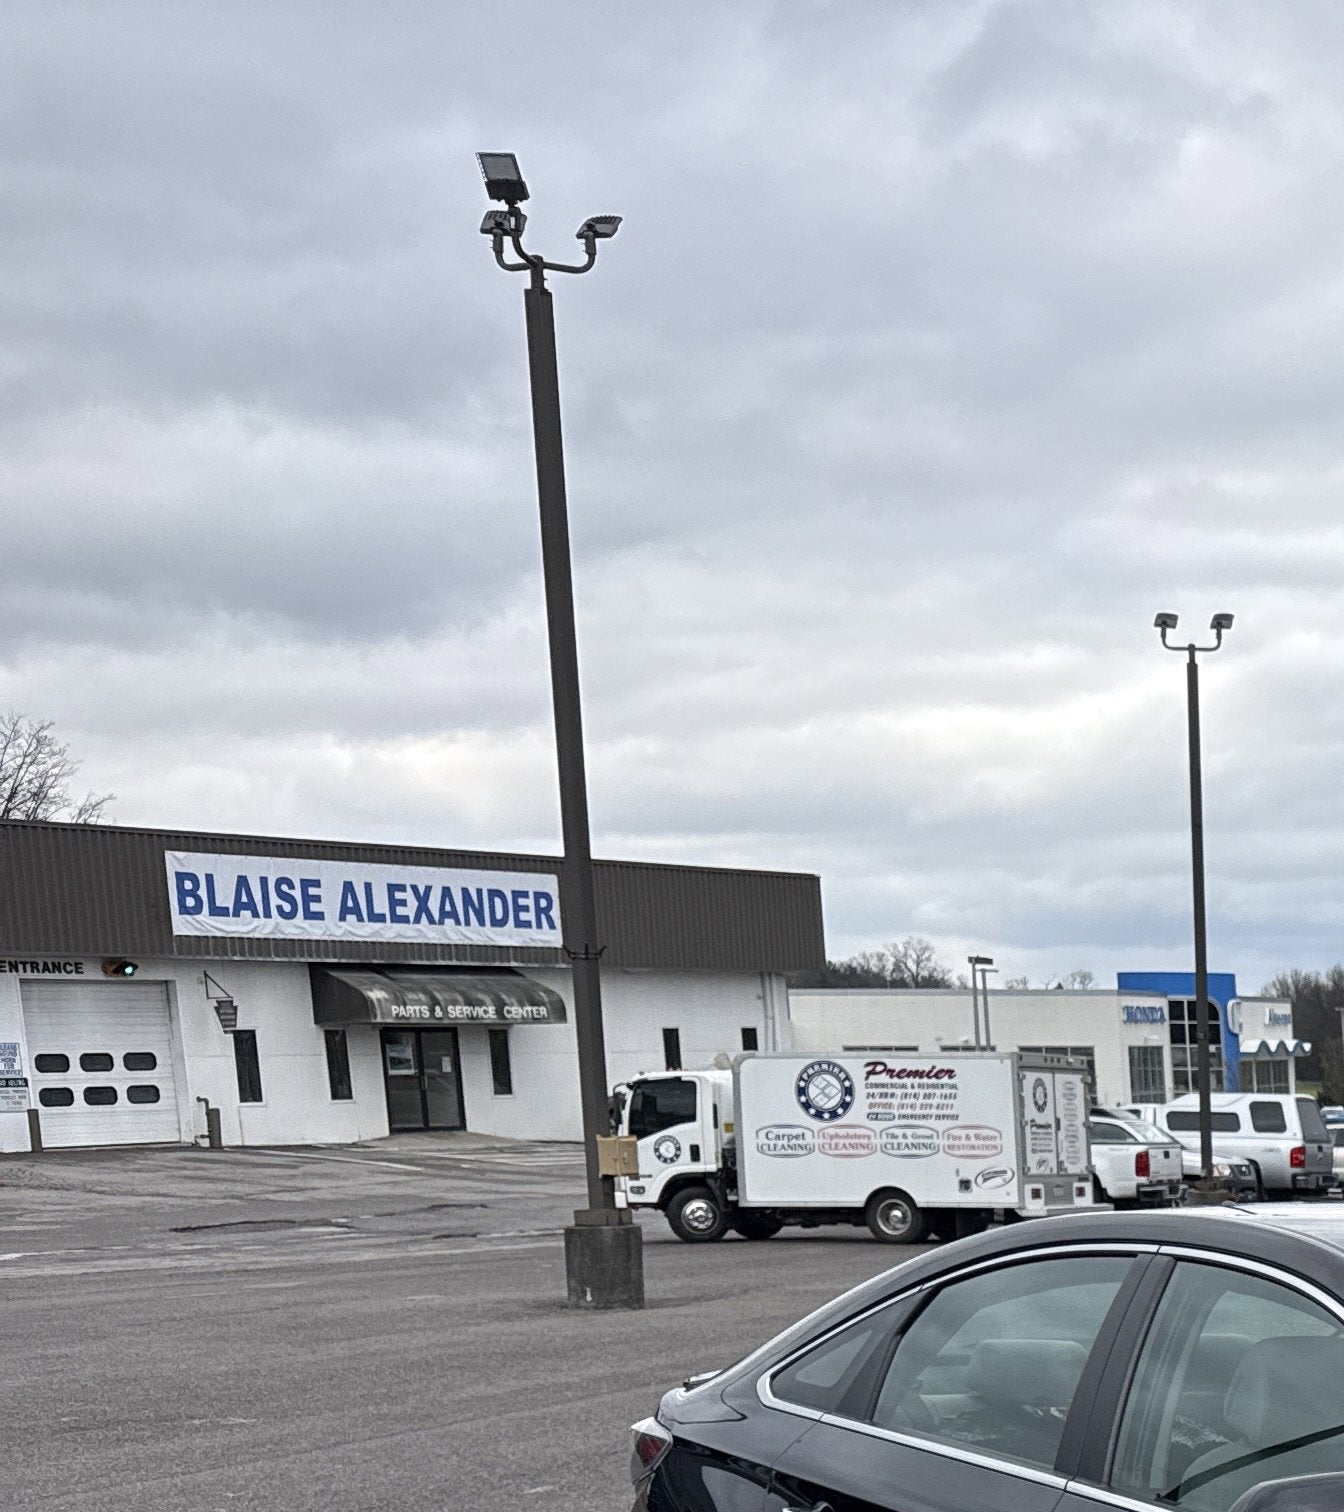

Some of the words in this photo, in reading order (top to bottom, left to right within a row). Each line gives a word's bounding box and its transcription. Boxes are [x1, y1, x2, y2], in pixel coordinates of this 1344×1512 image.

[174, 870, 326, 922] BLAISE
[337, 880, 558, 931] ALEXANDER
[0, 960, 85, 975] ENTRANCE
[391, 1004, 430, 1019] PARTS
[434, 1005, 443, 1018] &
[447, 1005, 497, 1019] SERVICE
[503, 1005, 548, 1019] CENTER
[1123, 1005, 1166, 1024] HONDA
[863, 1060, 957, 1081] Premier
[765, 1130, 805, 1143] Carpet
[760, 1143, 812, 1152] CLEANING
[821, 1142, 874, 1151] CLEANING
[883, 1142, 937, 1151] CLEANING
